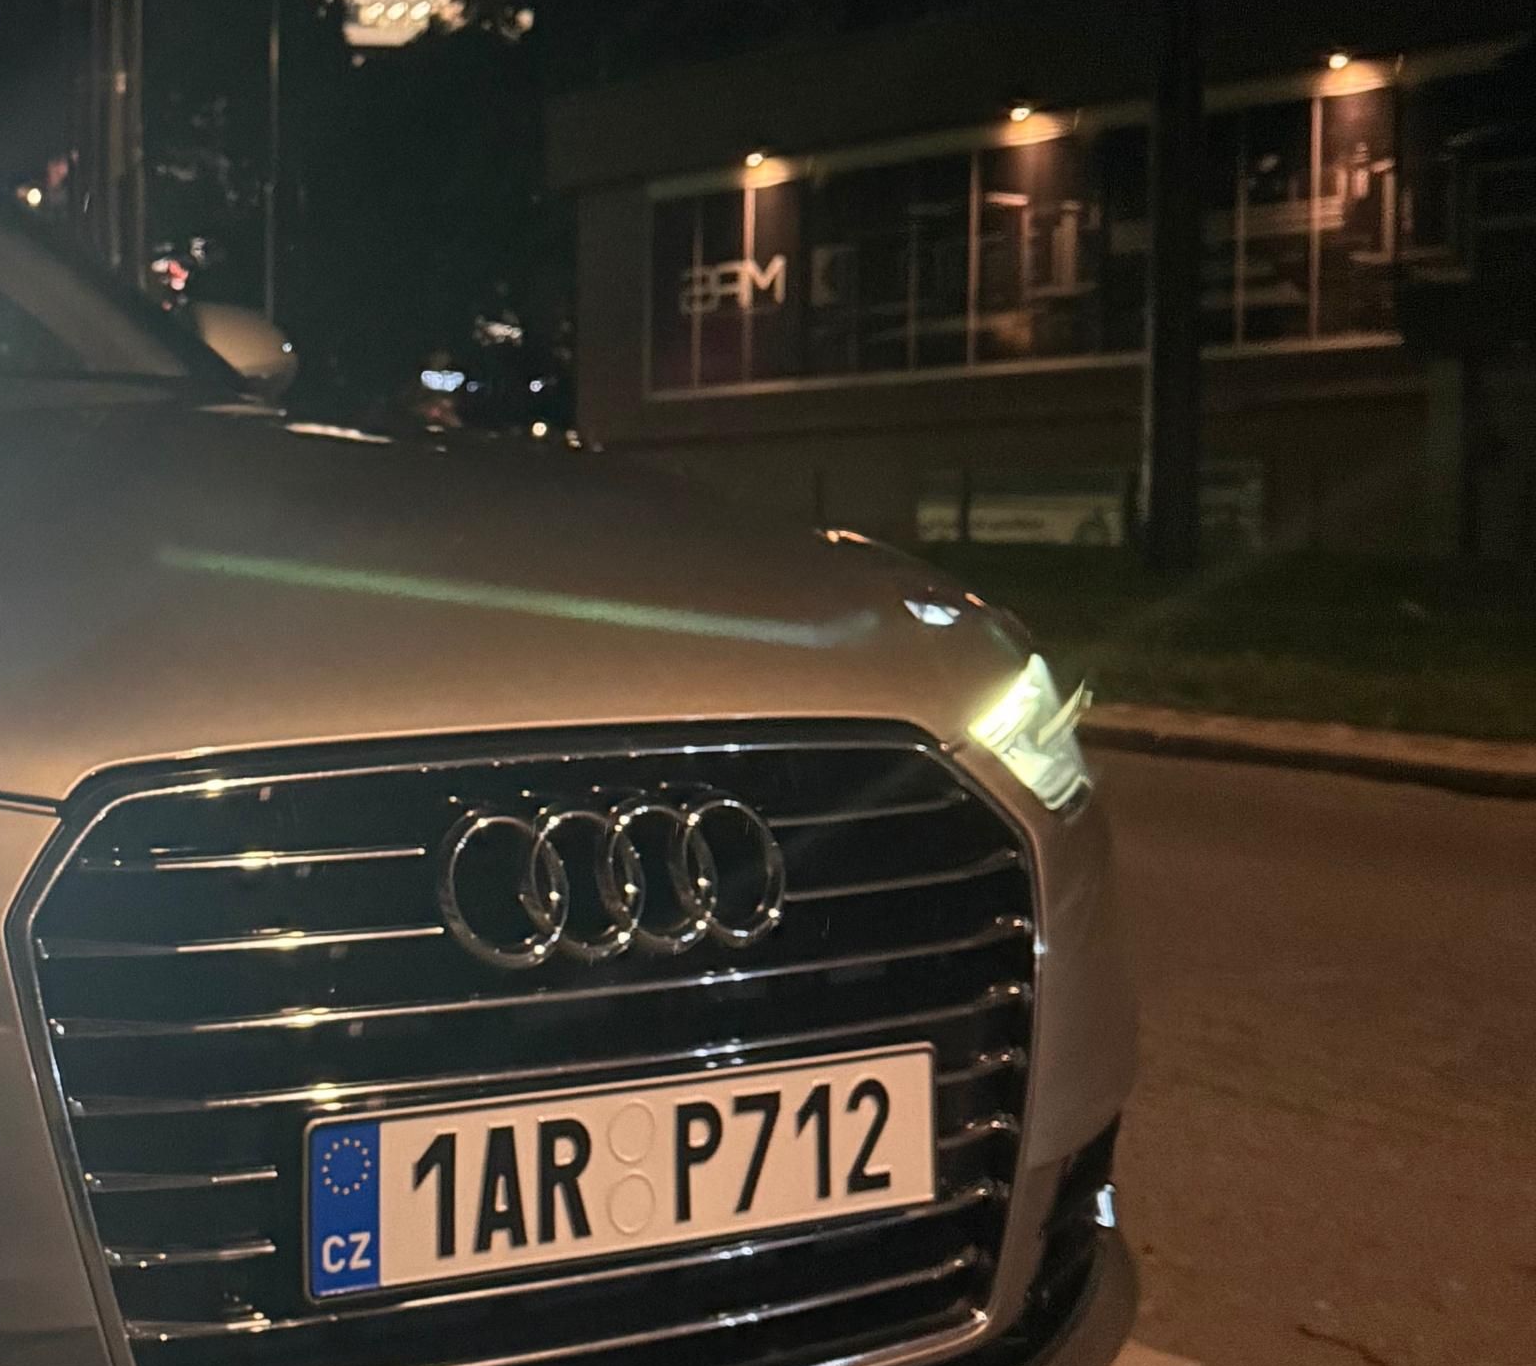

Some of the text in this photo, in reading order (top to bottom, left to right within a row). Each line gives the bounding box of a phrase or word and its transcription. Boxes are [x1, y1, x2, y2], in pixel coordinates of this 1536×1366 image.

[413, 1077, 892, 1259] 1AR P712
[322, 1231, 371, 1274] CZ
